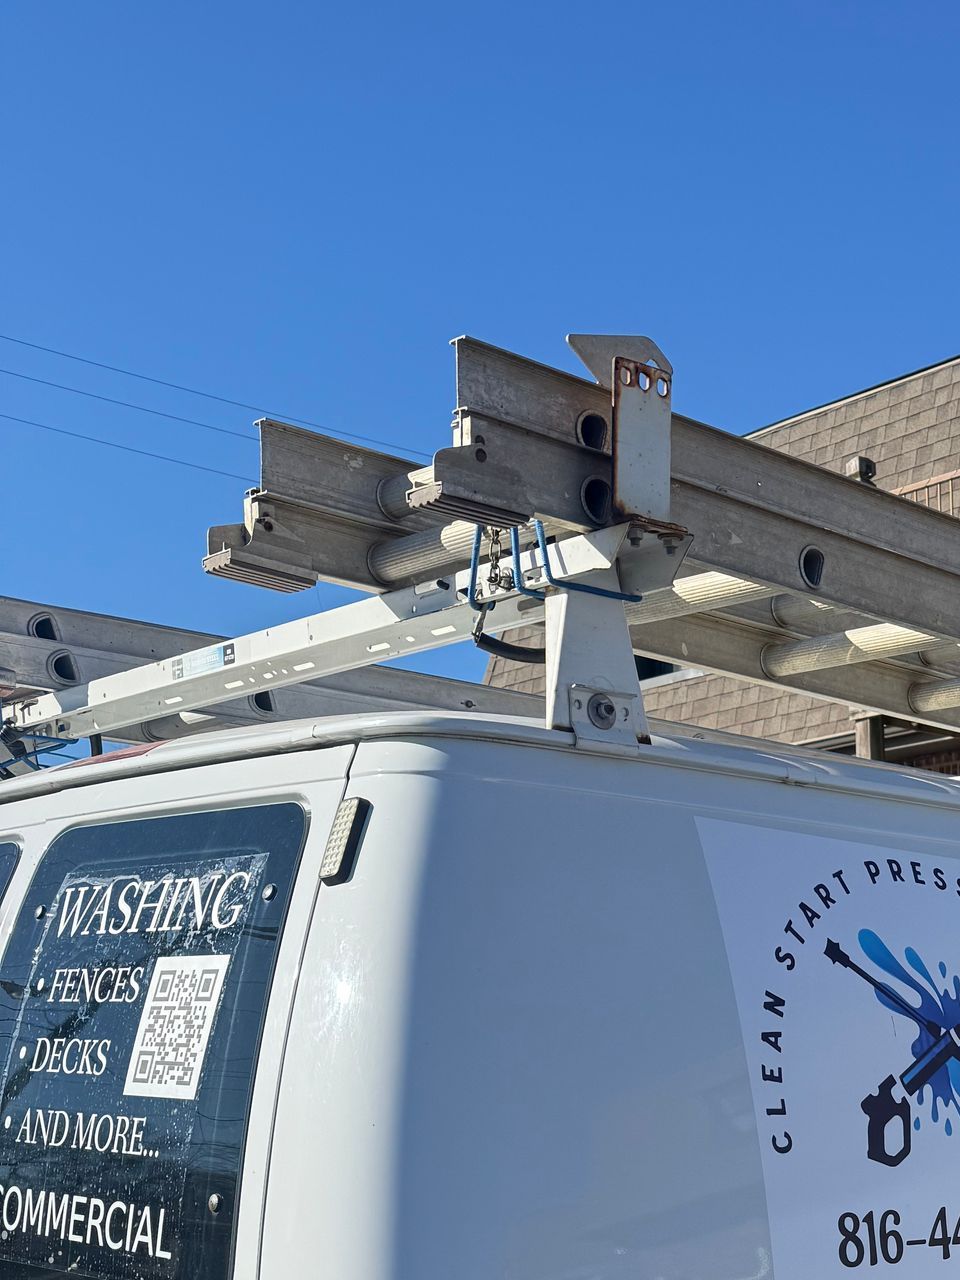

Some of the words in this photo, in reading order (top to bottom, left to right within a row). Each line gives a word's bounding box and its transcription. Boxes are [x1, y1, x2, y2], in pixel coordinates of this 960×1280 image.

[57, 870, 252, 938] WASHING
[775, 870, 853, 971] START
[47, 966, 144, 1004] FENCES
[29, 1036, 110, 1076] DECKS
[761, 989, 793, 1155] CLEAN
[15, 1107, 70, 1149] AND
[71, 1112, 159, 1158] MORE...
[0, 1184, 172, 1260] OMMERCIAL
